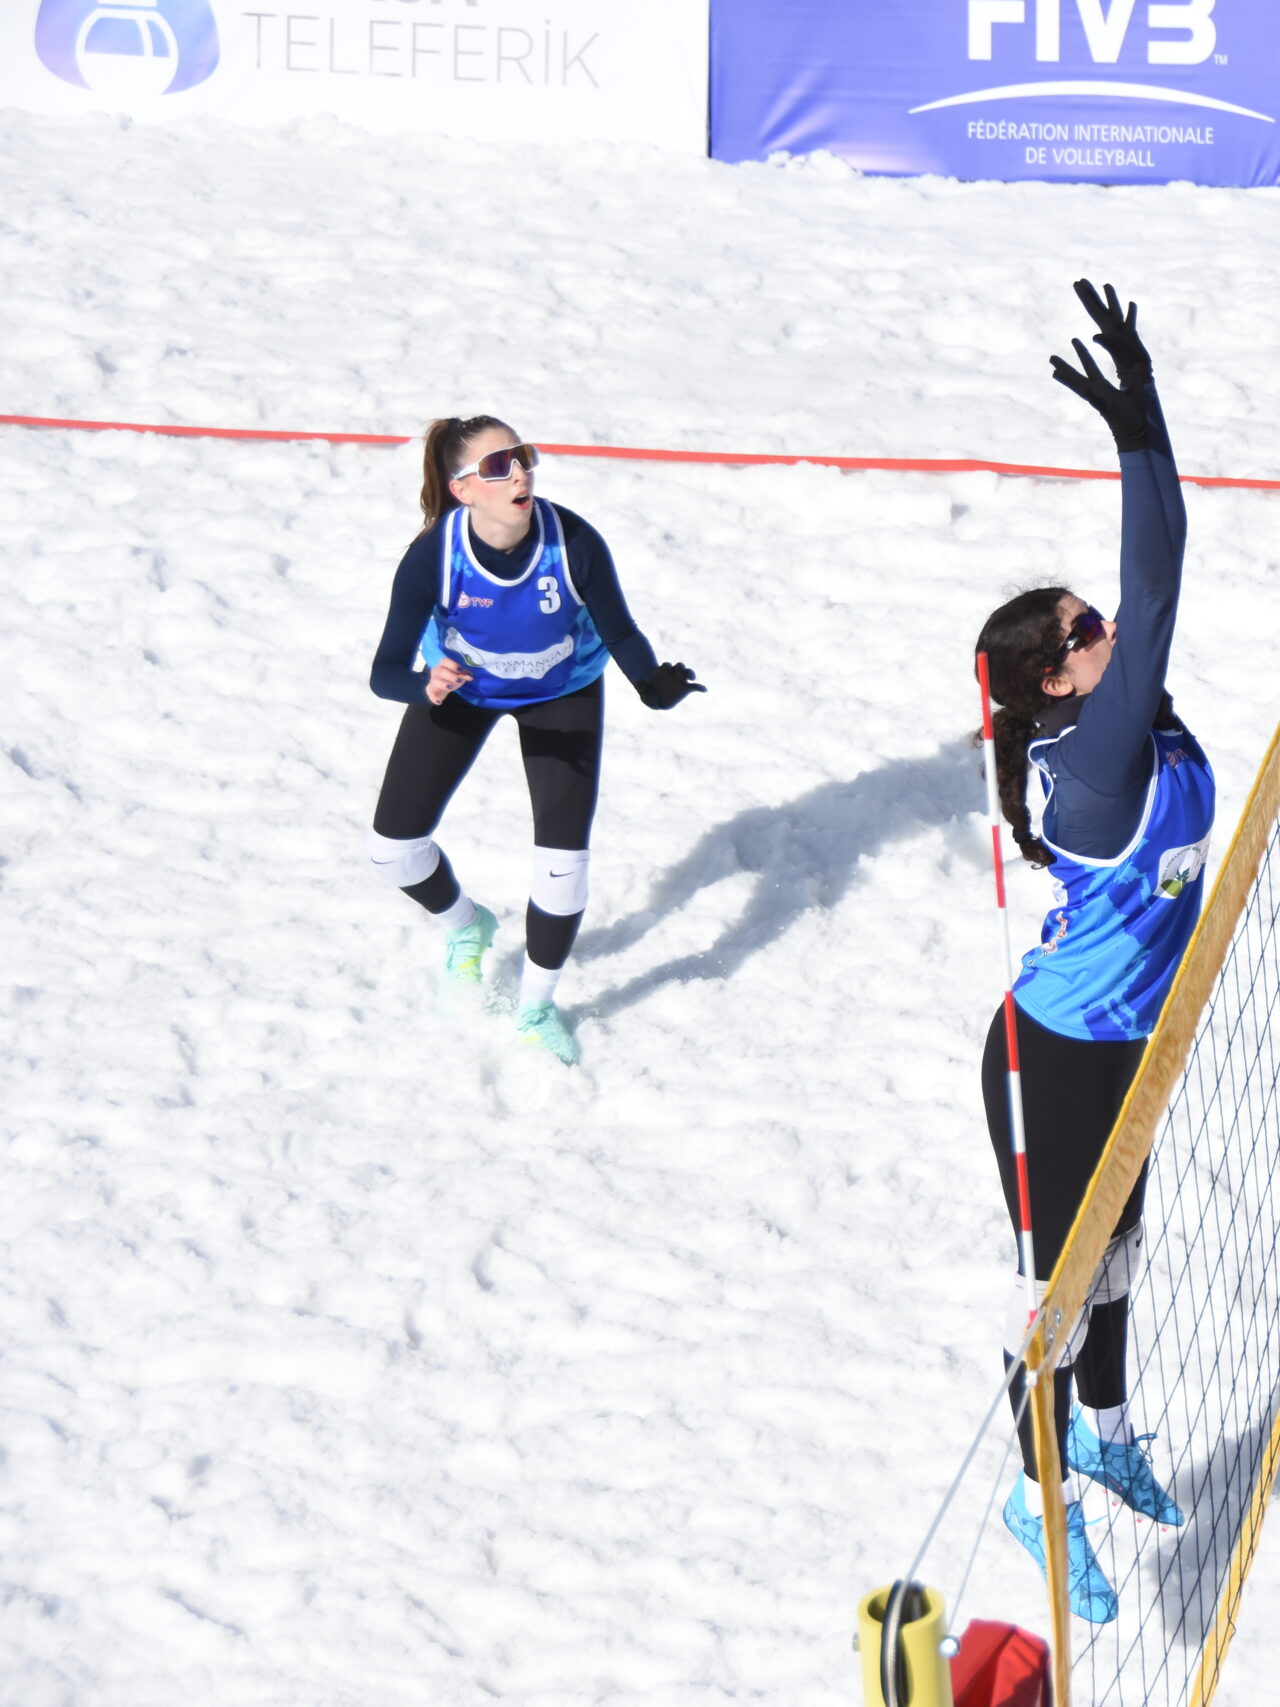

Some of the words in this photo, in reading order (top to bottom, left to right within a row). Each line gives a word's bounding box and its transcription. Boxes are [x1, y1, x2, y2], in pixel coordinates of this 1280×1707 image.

[242, 12, 600, 89] TELEFERİK
[968, 0, 1217, 65] FIVB
[967, 119, 1070, 142] FÉDÉRATION
[1073, 124, 1214, 145] INTERNATIONALE
[1025, 146, 1048, 165] DE
[1052, 147, 1156, 168] VOLLEYBALL
[537, 575, 562, 615] 3
